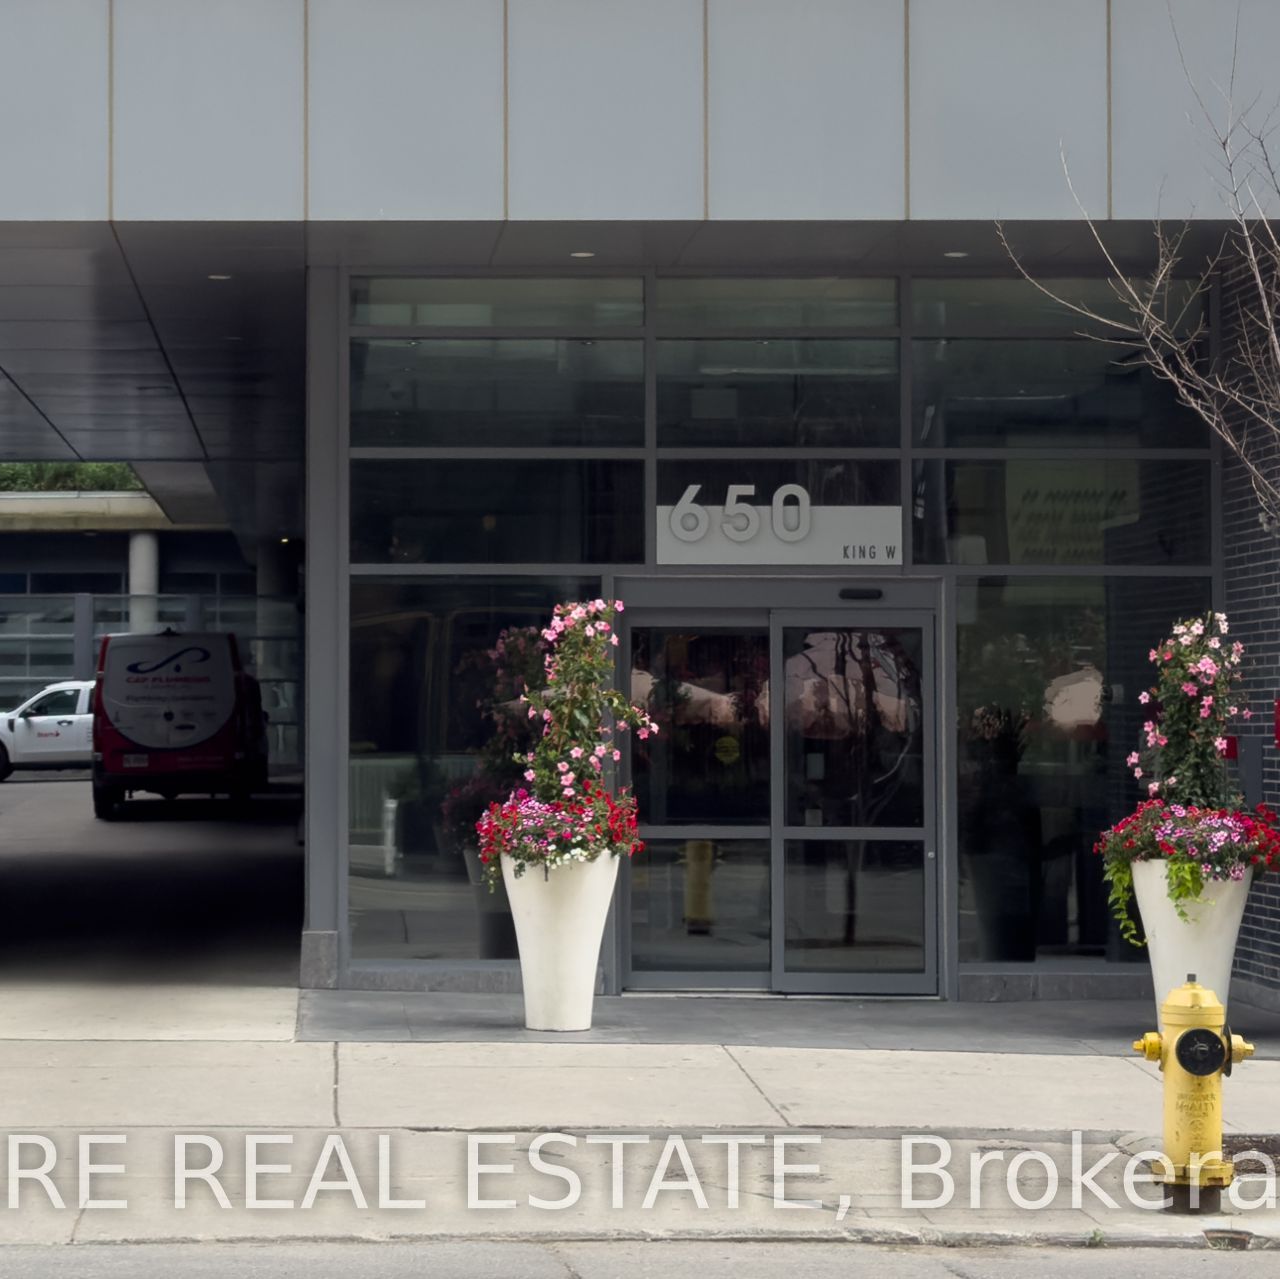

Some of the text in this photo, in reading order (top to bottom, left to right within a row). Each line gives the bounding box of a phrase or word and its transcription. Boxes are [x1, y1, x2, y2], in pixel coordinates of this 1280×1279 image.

[670, 483, 812, 543] 650
[843, 545, 897, 559] KING W
